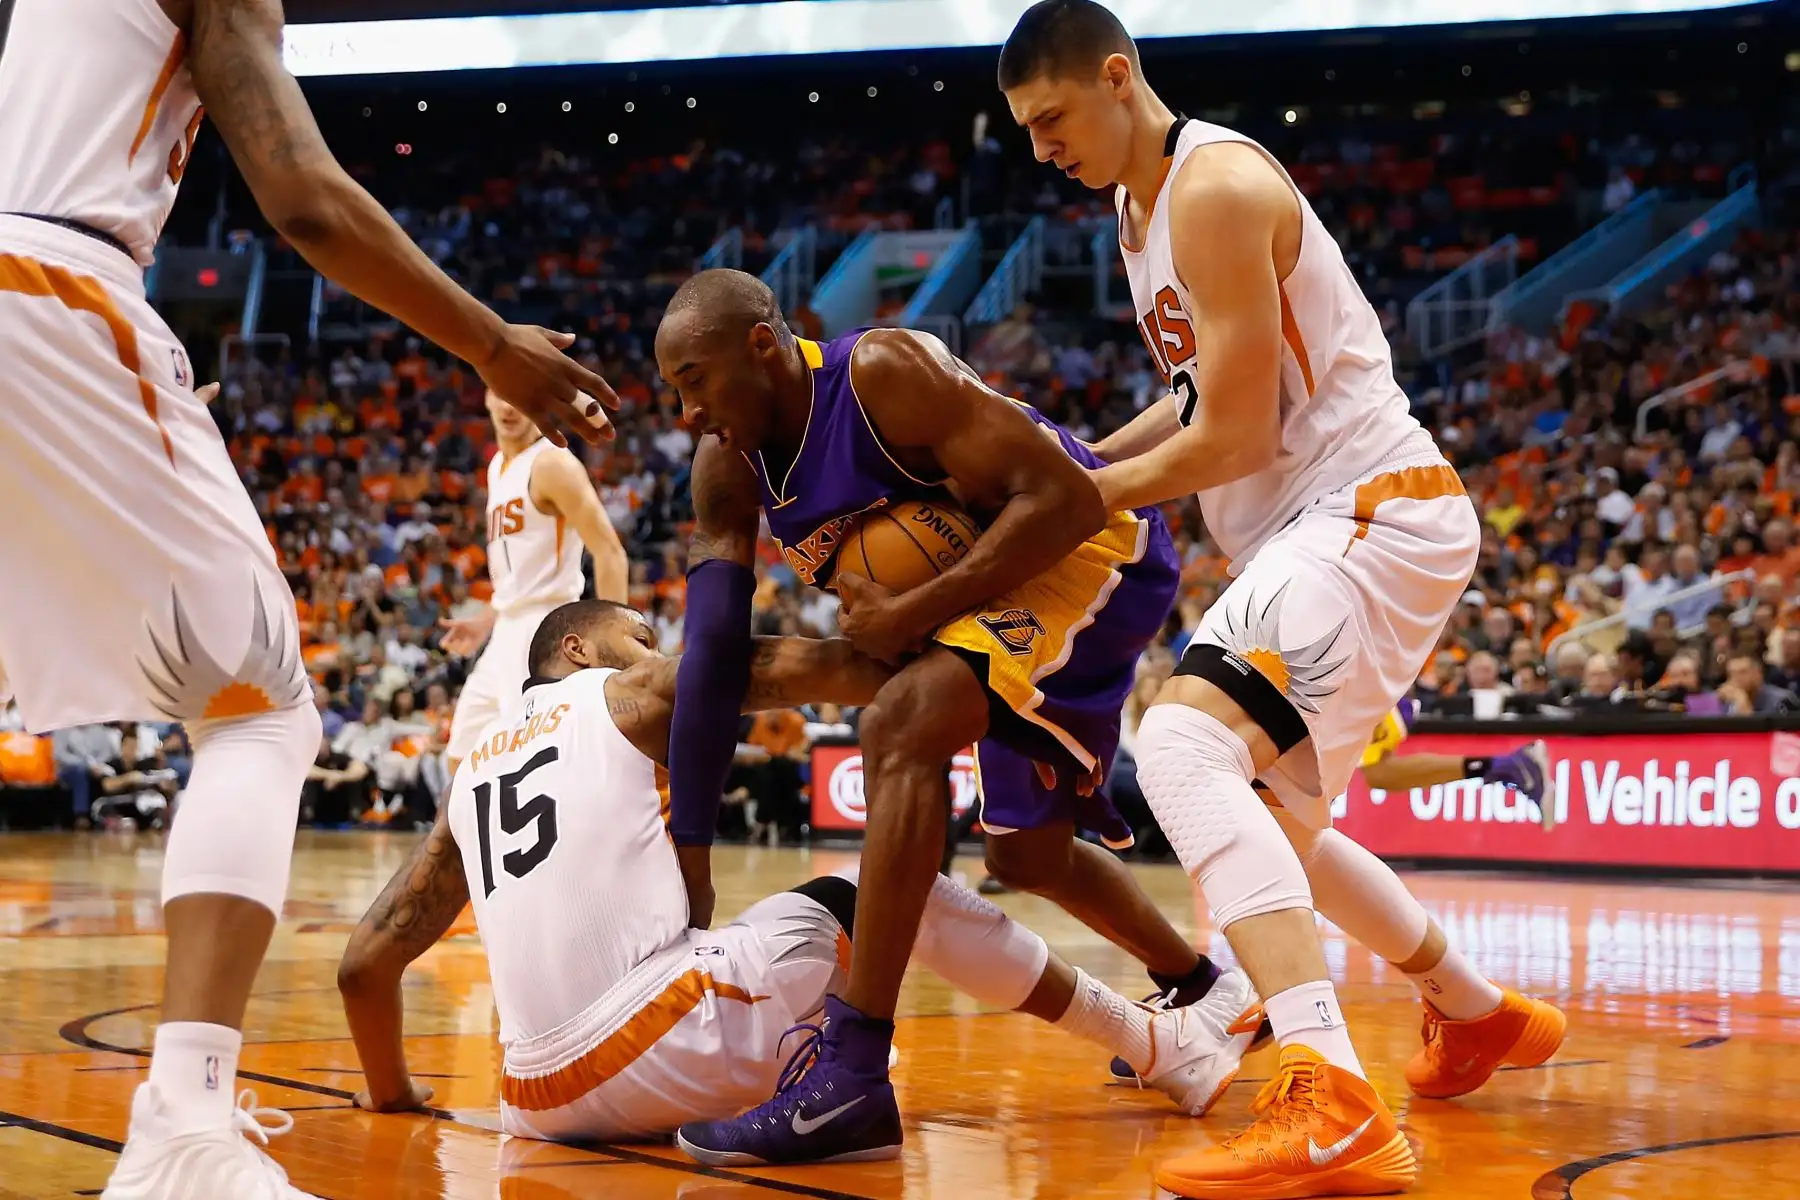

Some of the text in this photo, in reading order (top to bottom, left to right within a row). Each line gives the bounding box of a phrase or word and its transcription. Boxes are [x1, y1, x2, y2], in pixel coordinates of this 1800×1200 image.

[470, 703, 570, 774] MORRIS
[471, 745, 559, 900] 15
[1581, 758, 1761, 829] Vehicle
